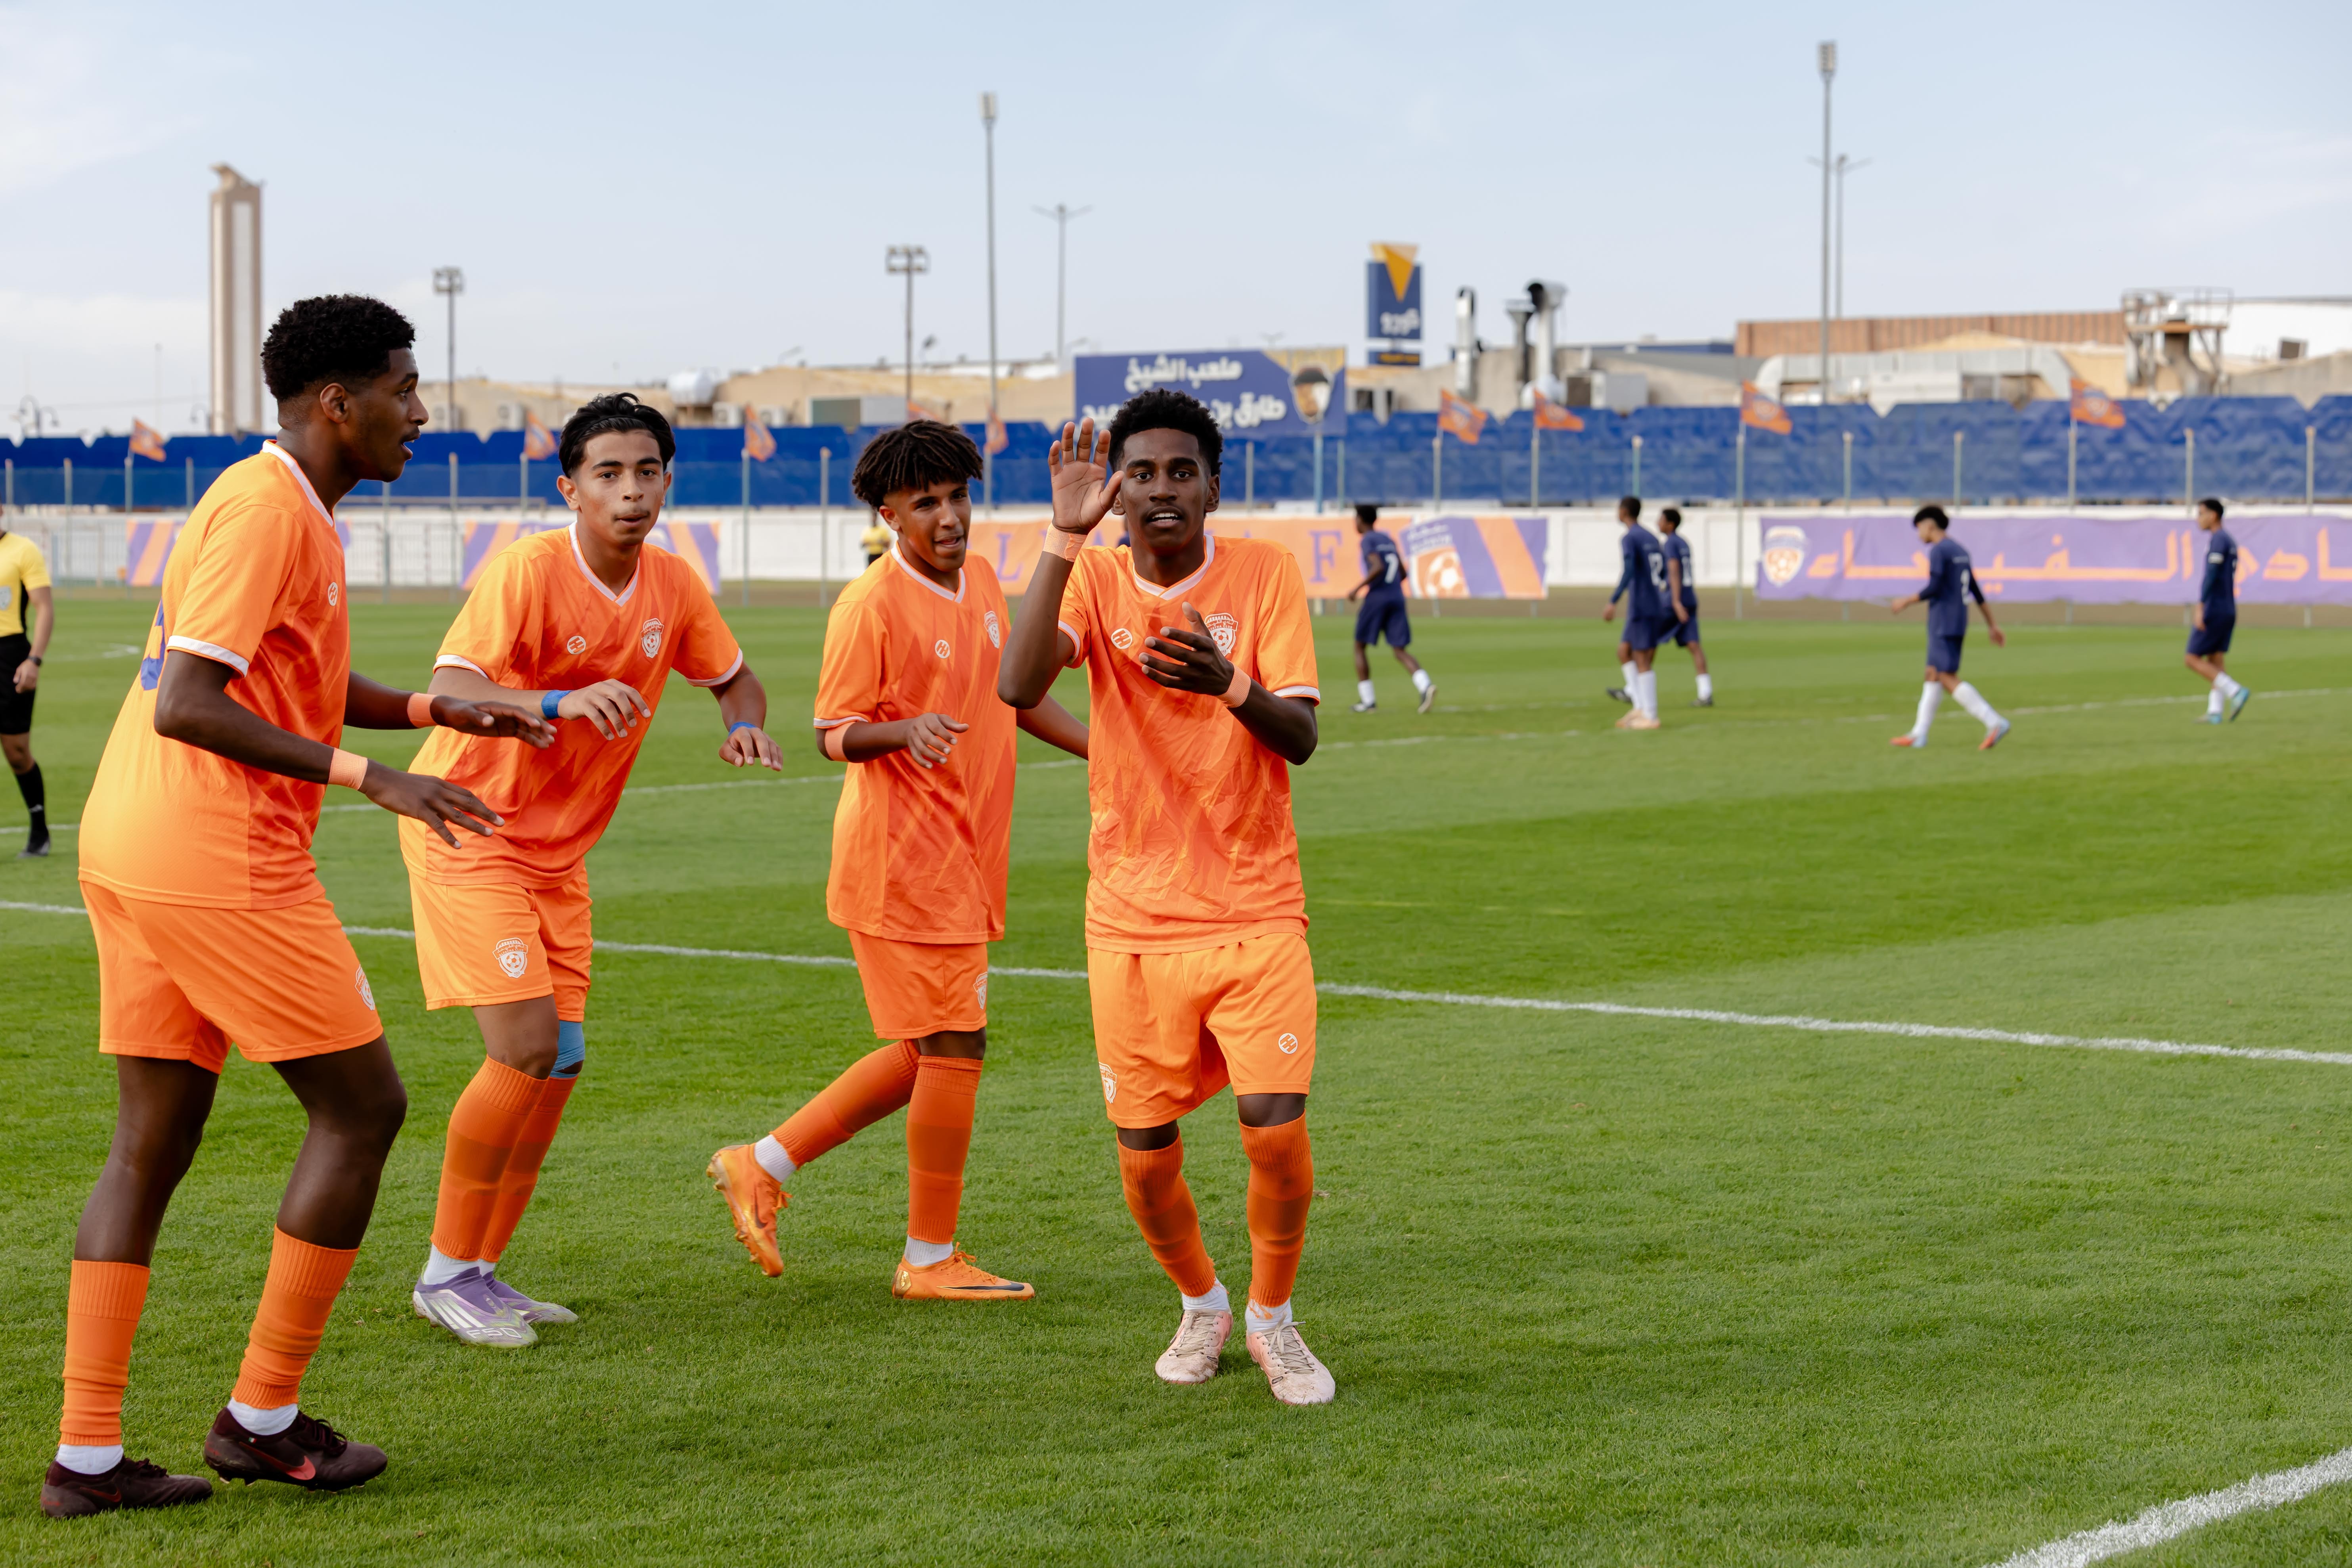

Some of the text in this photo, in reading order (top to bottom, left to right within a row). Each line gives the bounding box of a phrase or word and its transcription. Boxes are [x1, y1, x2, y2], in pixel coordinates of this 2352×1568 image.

[1124, 352, 1243, 394] ملعب الشيخ
[1233, 391, 1287, 428] طارق
[466, 1328, 522, 1339] F50
